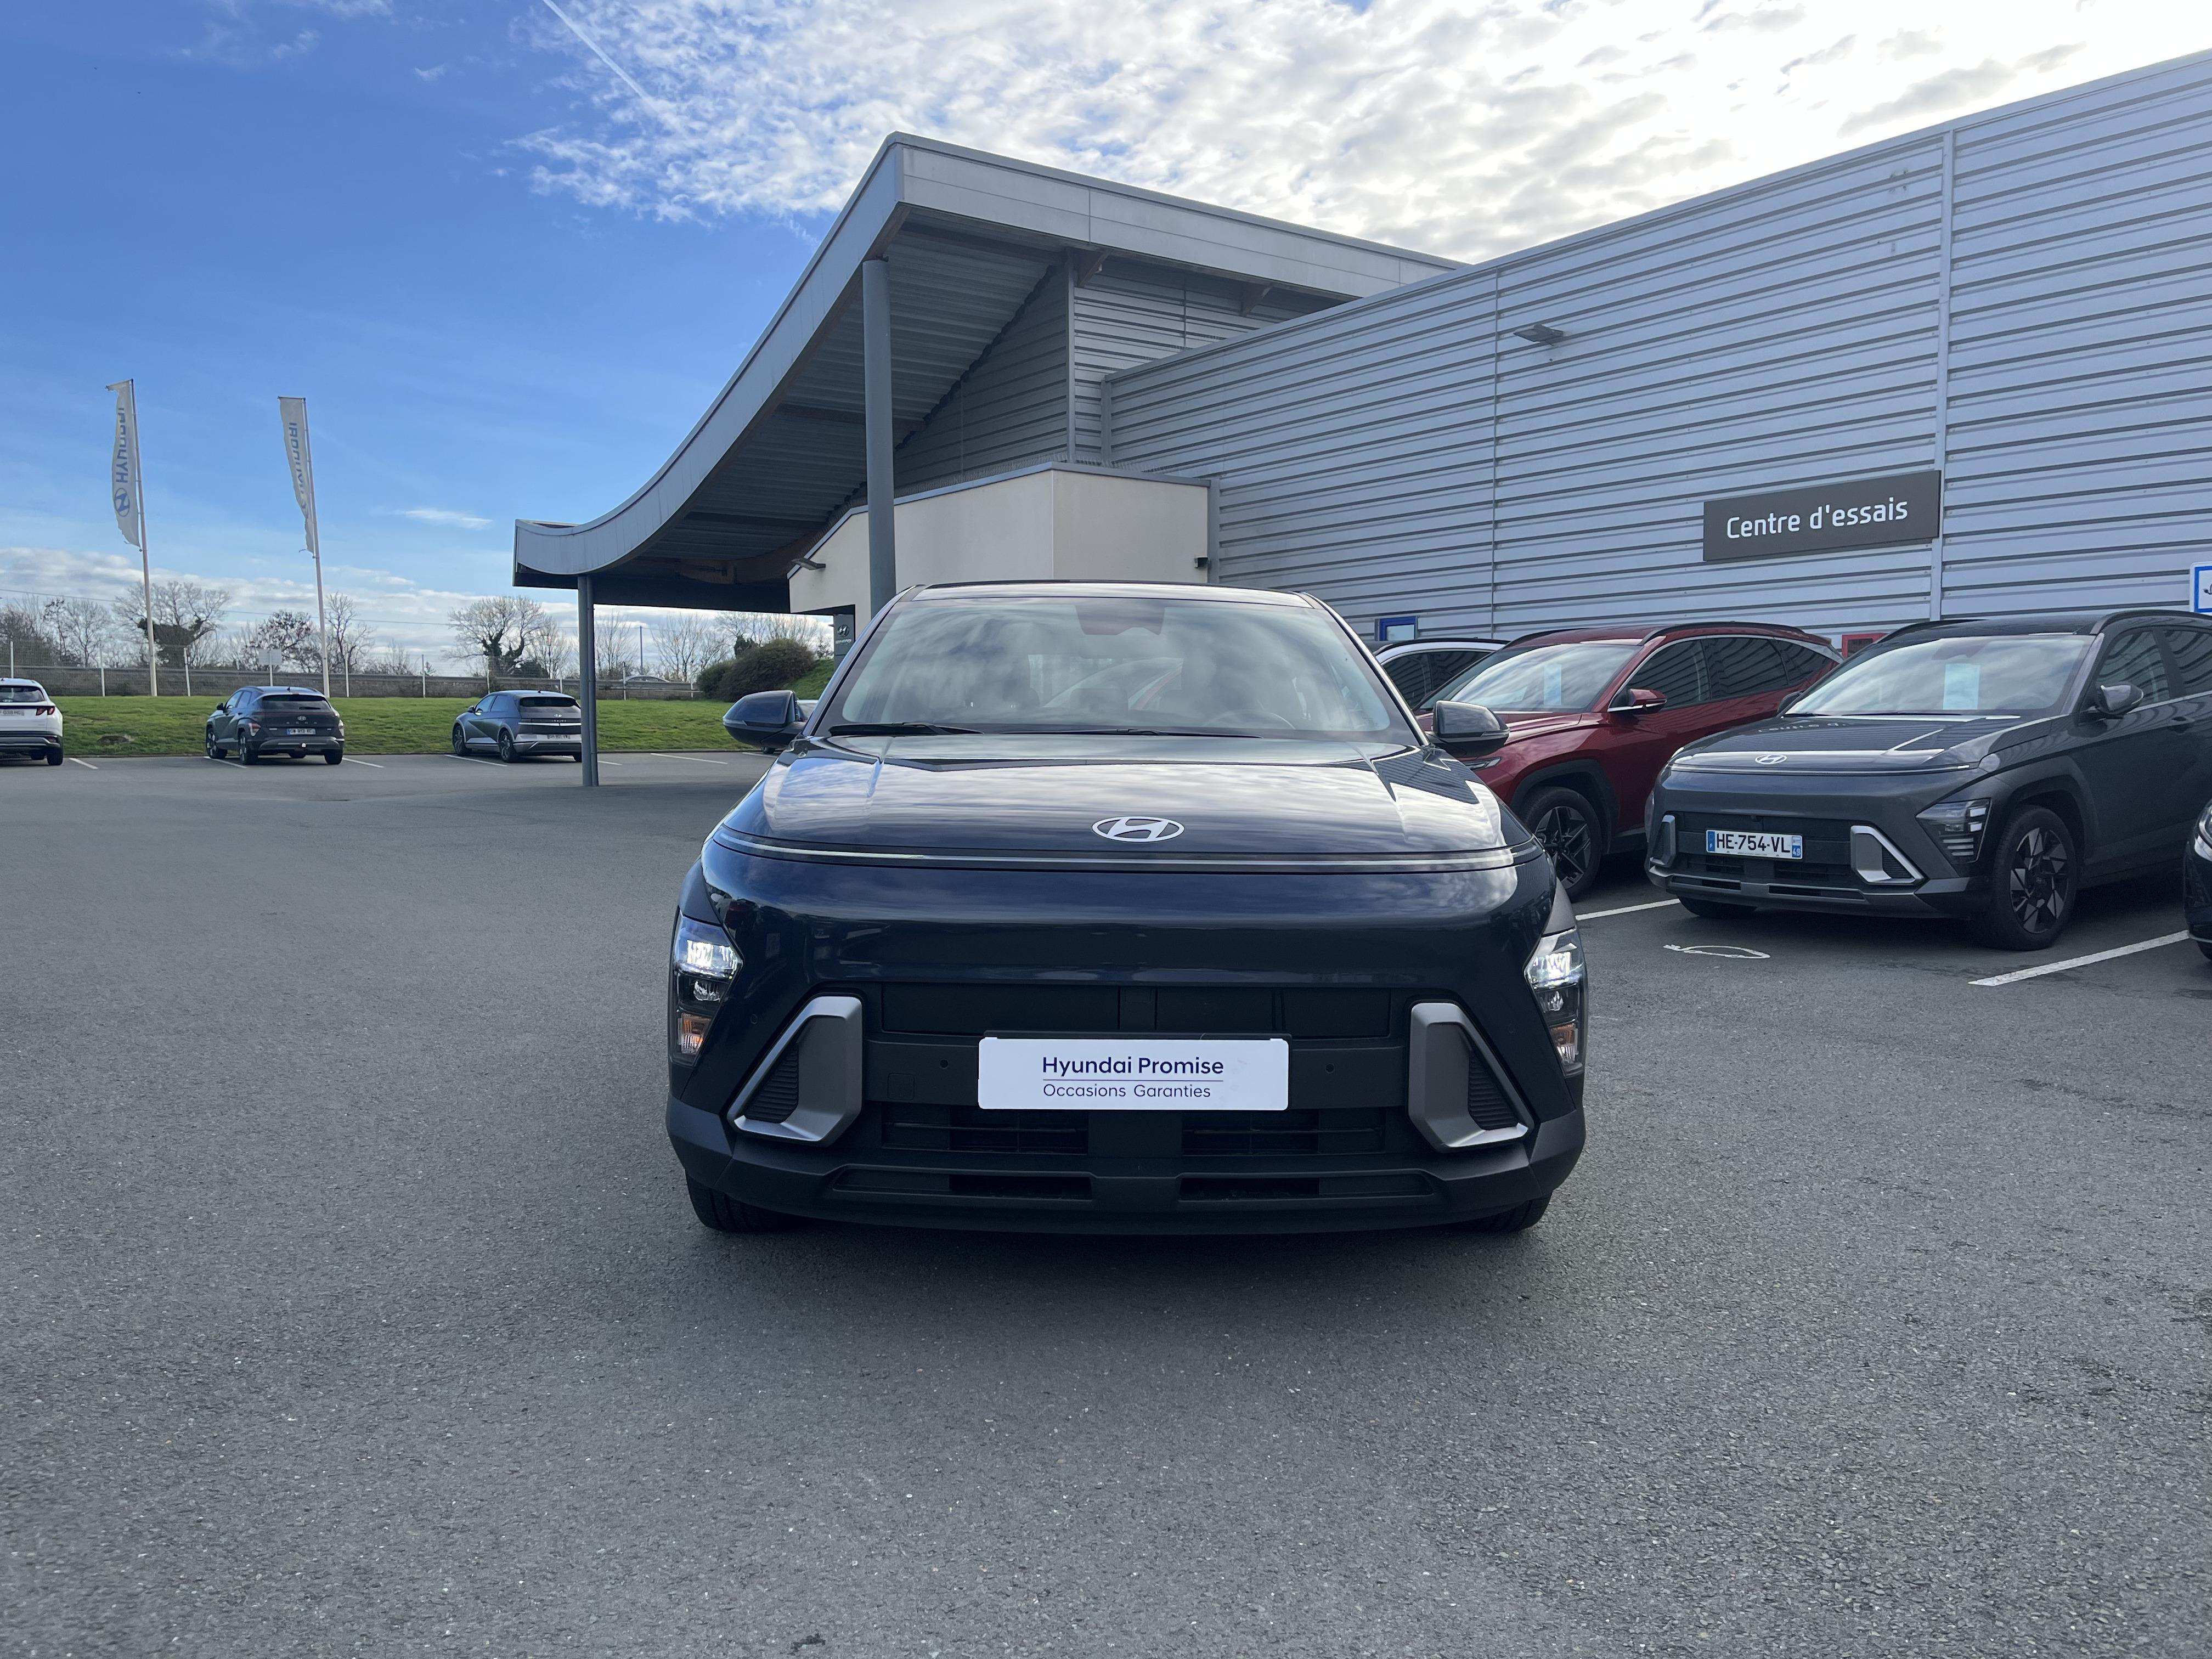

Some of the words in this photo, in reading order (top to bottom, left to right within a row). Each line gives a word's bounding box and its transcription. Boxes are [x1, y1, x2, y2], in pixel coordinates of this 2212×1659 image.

[1727, 512, 1801, 539] Centre
[1810, 496, 1908, 529] d'essais
[1717, 833, 1791, 853] HE-754-VL
[1043, 1057, 1131, 1076] Hyundai
[1138, 1057, 1224, 1074] Promise
[1043, 1084, 1126, 1097] Occasions
[1133, 1084, 1211, 1097] Garanties
